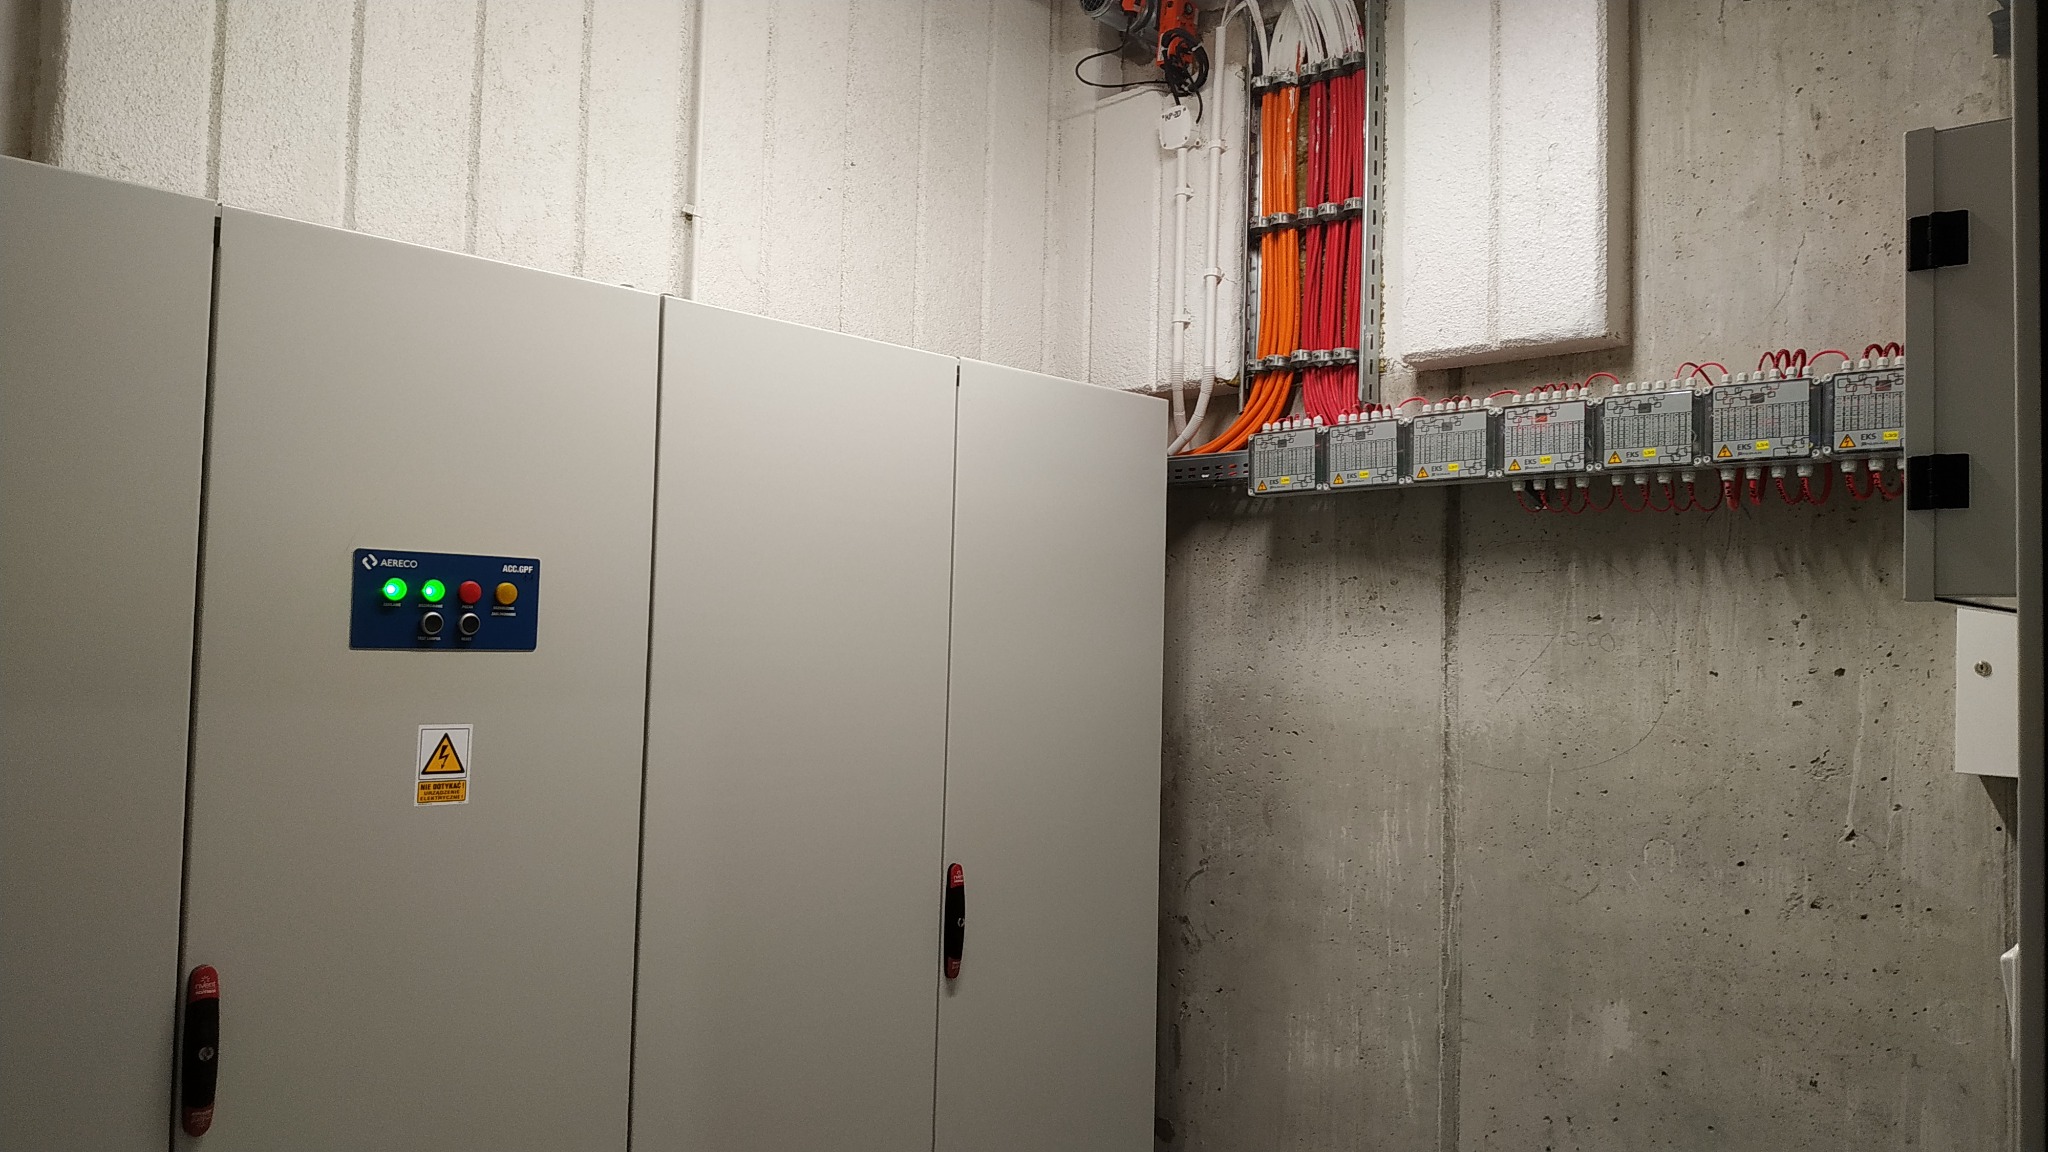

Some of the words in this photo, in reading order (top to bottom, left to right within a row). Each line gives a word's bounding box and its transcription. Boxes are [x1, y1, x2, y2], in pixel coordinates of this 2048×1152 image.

[1860, 433, 1877, 441] EKS
[1736, 443, 1752, 451] EKS
[1524, 458, 1537, 466] EKS
[380, 558, 418, 568] AERECO
[502, 564, 534, 574] ACC.GPF
[433, 781, 461, 790] DOTYKAĆ
